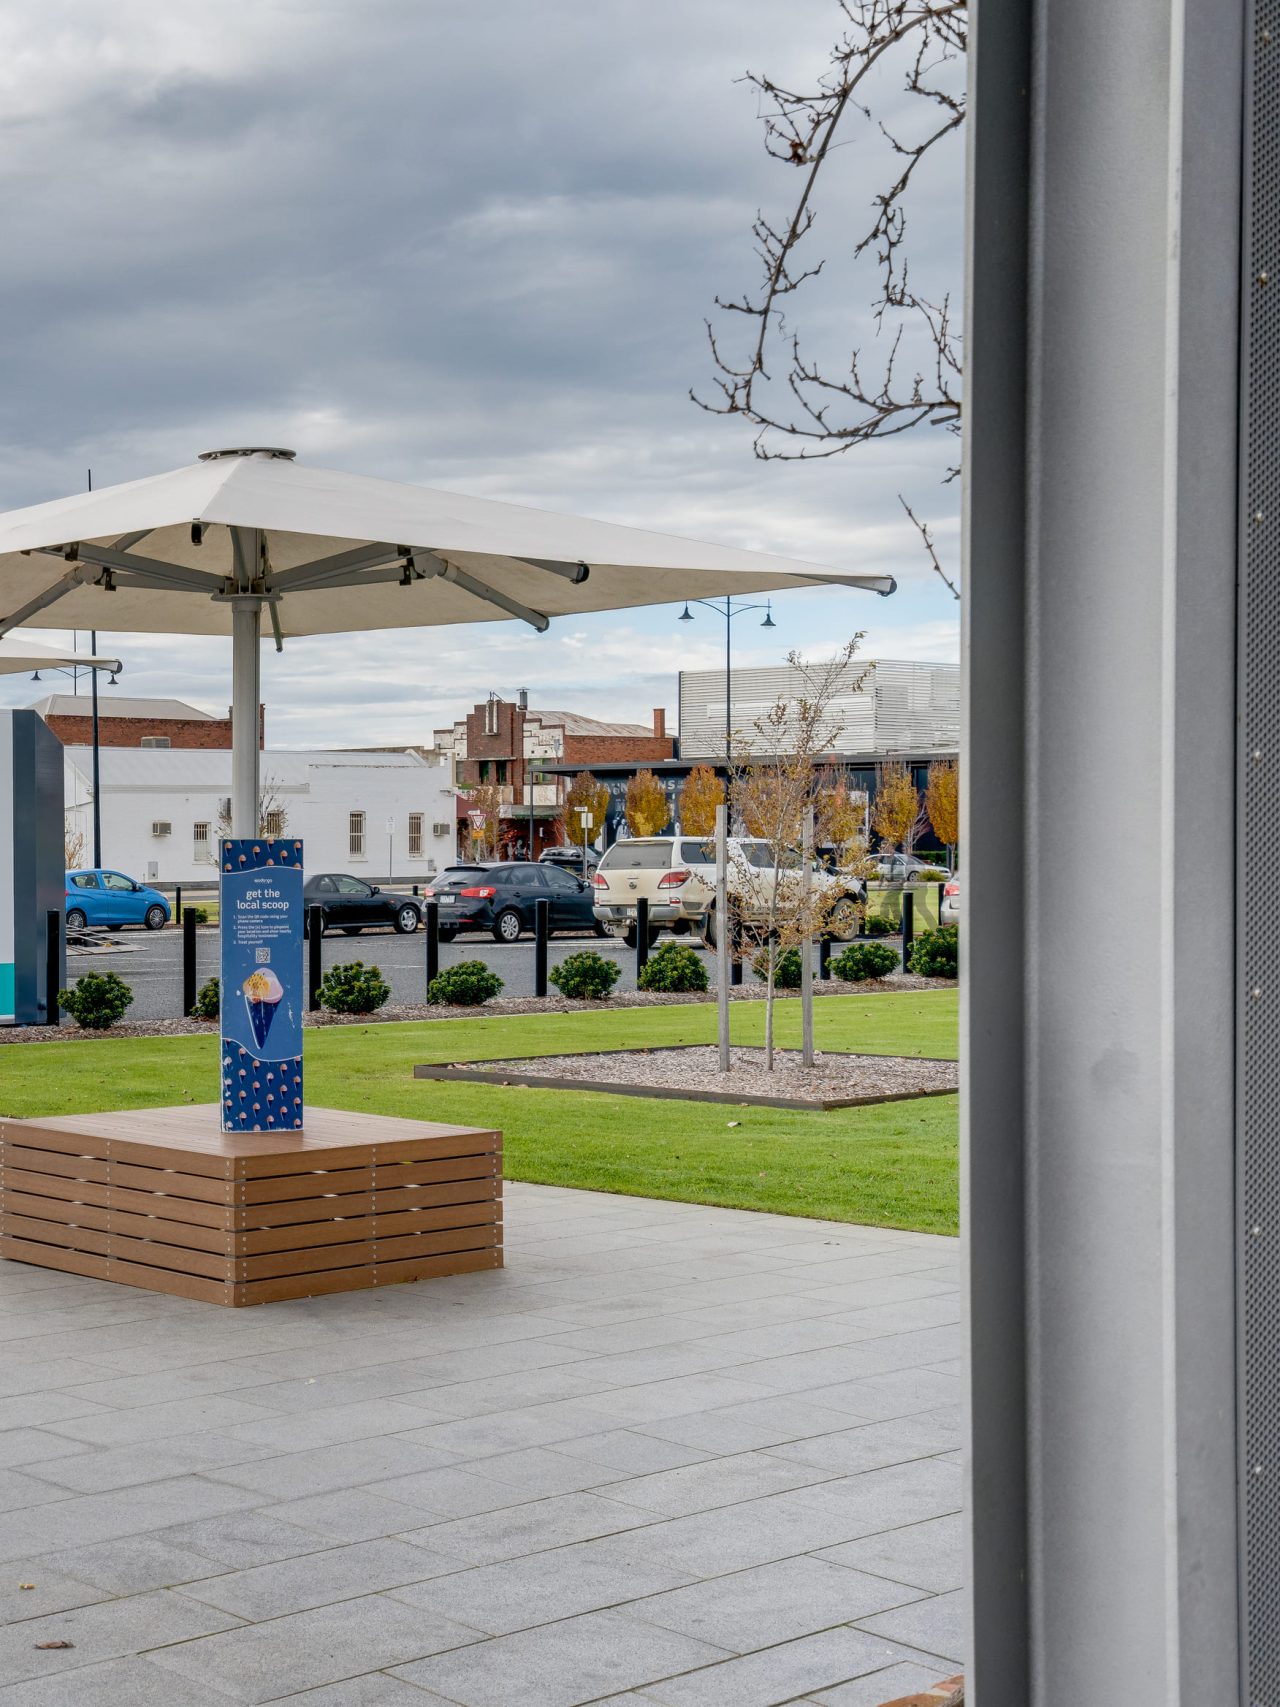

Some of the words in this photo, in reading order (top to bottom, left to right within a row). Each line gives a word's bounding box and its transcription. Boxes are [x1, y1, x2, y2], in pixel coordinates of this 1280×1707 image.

[246, 889, 262, 900] get
[264, 888, 280, 898] the
[237, 900, 260, 909] local
[262, 901, 289, 911] scoop
